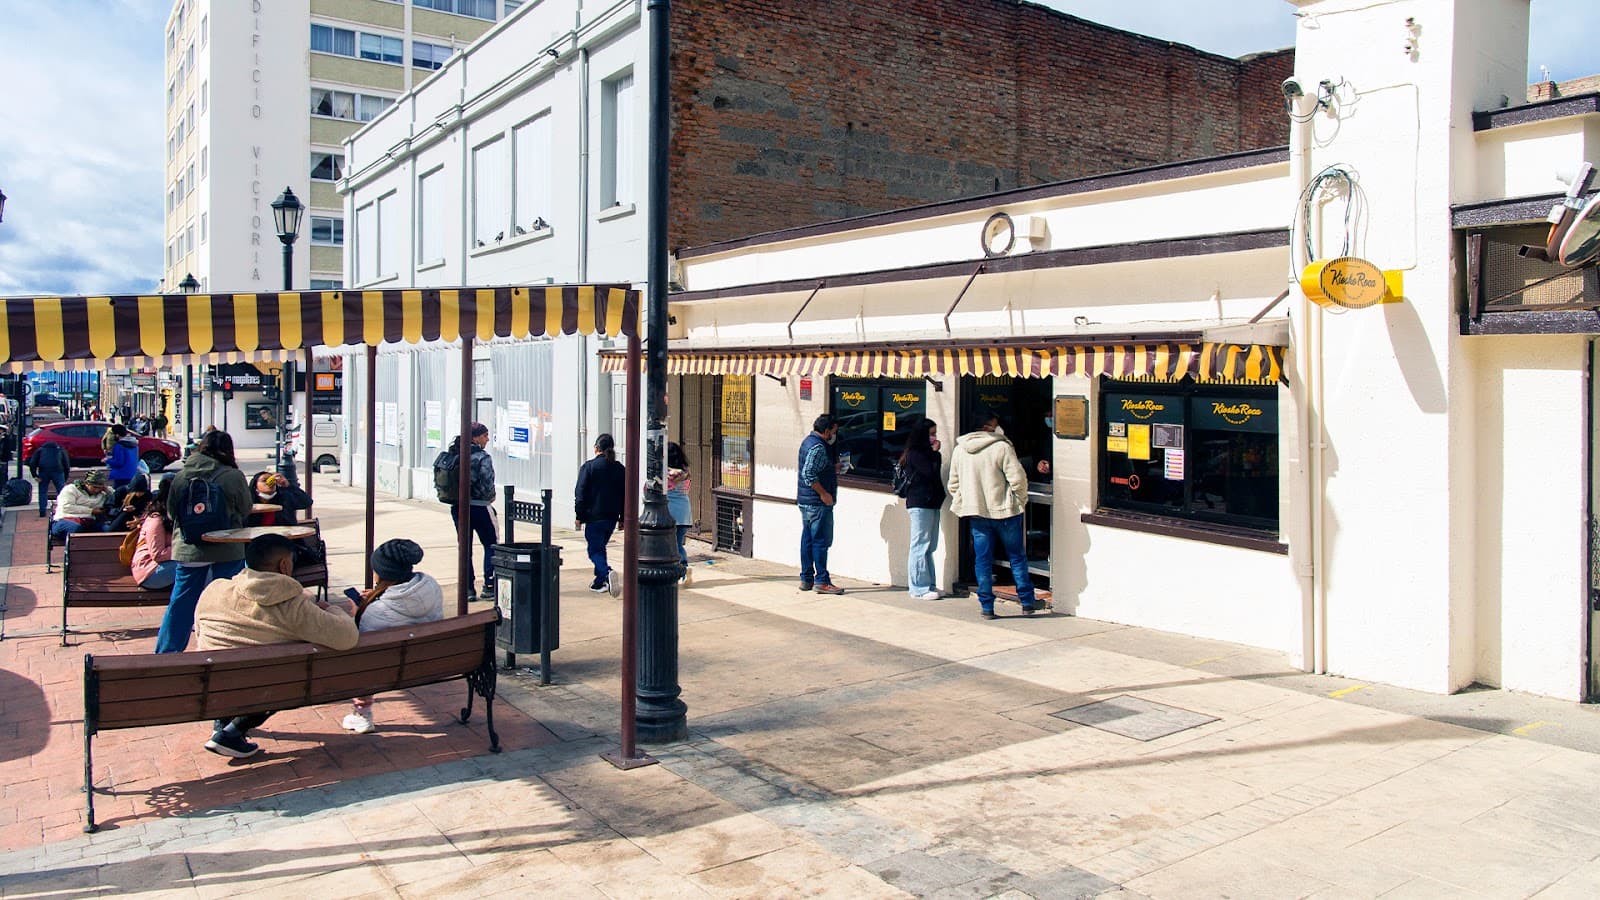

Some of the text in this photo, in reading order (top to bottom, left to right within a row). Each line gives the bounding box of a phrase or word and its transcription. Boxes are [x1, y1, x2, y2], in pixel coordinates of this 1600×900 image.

[252, 145, 261, 281] VICTORIA
[1330, 269, 1377, 288] Kiosko Roca
